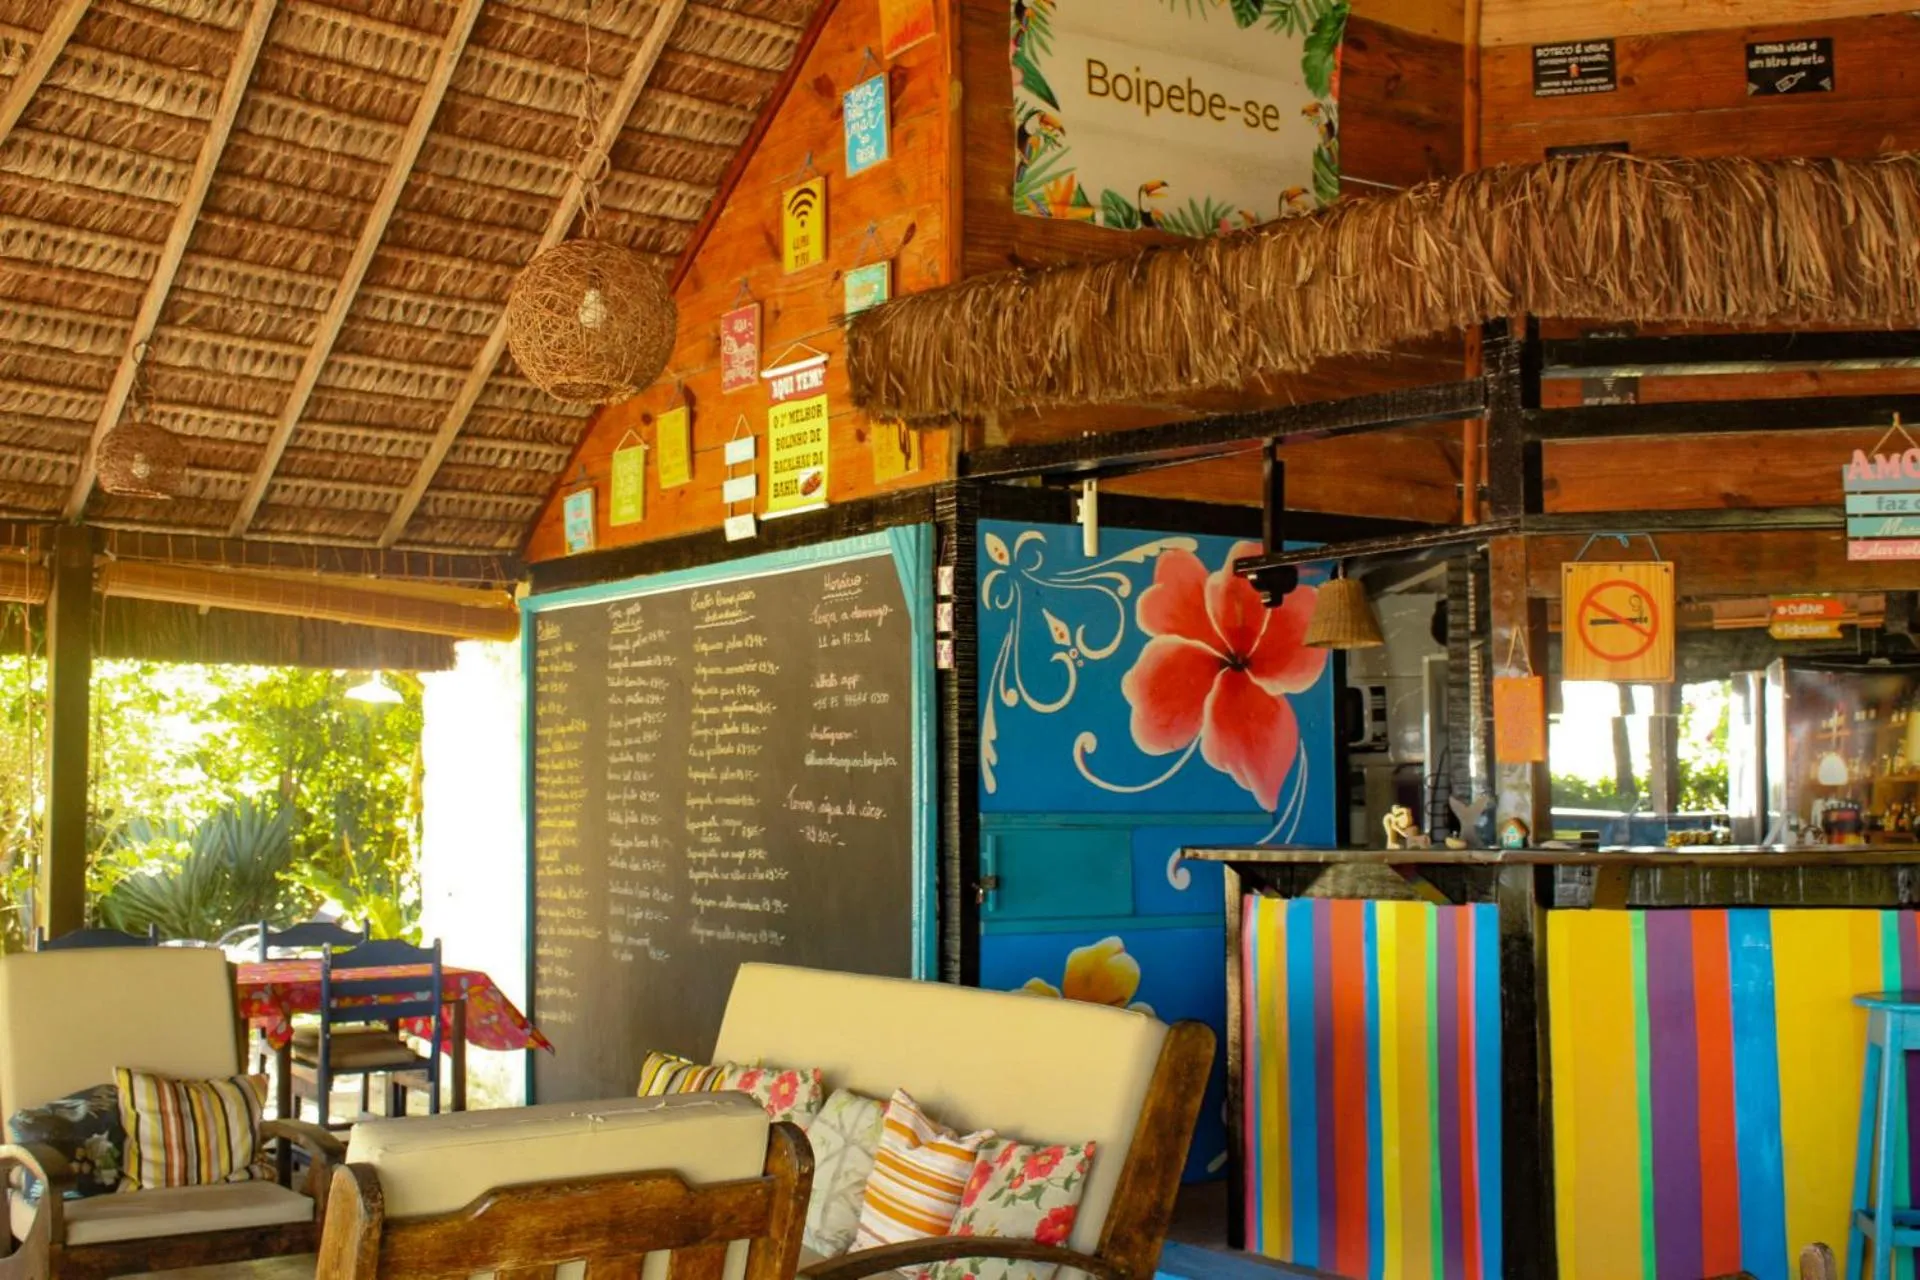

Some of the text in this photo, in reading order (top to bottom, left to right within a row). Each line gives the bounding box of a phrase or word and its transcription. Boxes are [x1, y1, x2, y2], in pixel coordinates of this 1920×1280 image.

[1086, 58, 1280, 132] Boipebe-se
[788, 403, 823, 425] MELHOR
[1876, 496, 1908, 511] faz
